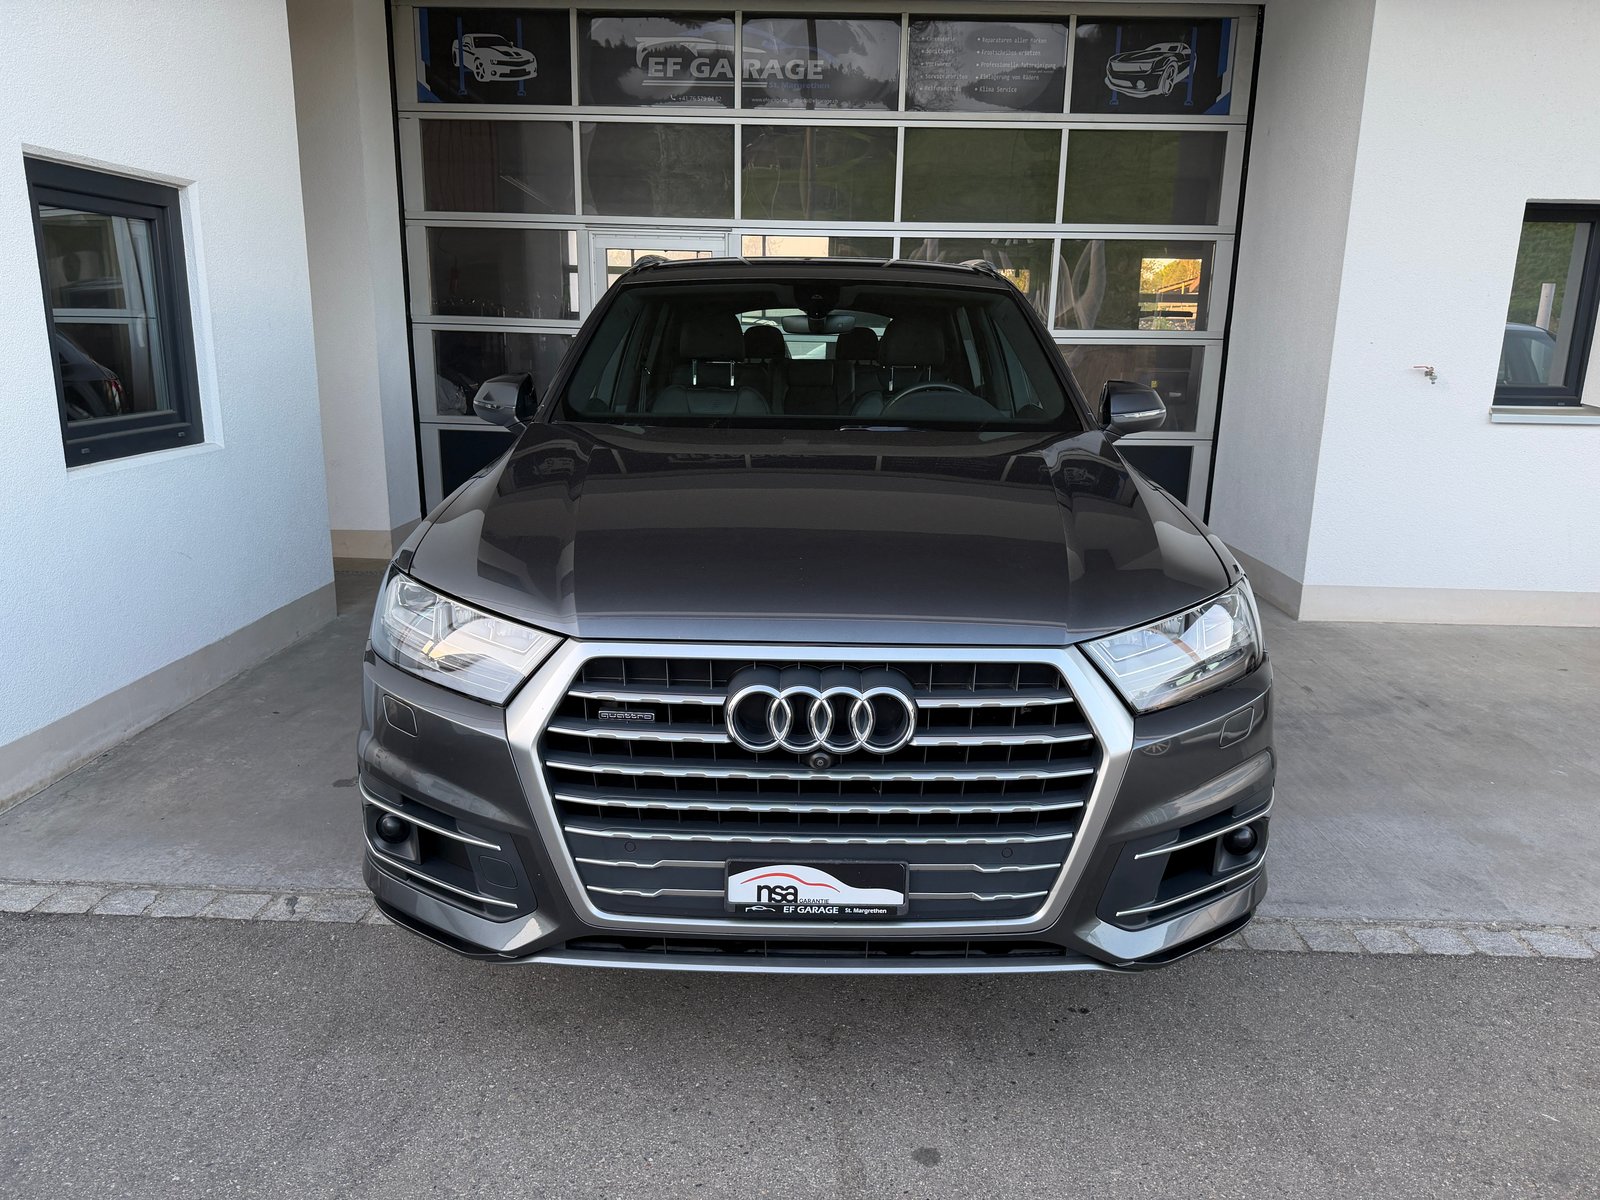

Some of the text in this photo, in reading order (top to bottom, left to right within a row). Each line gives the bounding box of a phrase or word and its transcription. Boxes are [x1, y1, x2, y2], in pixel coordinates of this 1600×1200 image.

[647, 57, 824, 80] EF GARAGE
[600, 712, 652, 720] quattro
[756, 885, 799, 903] nsa
[797, 906, 839, 914] GARAGE
